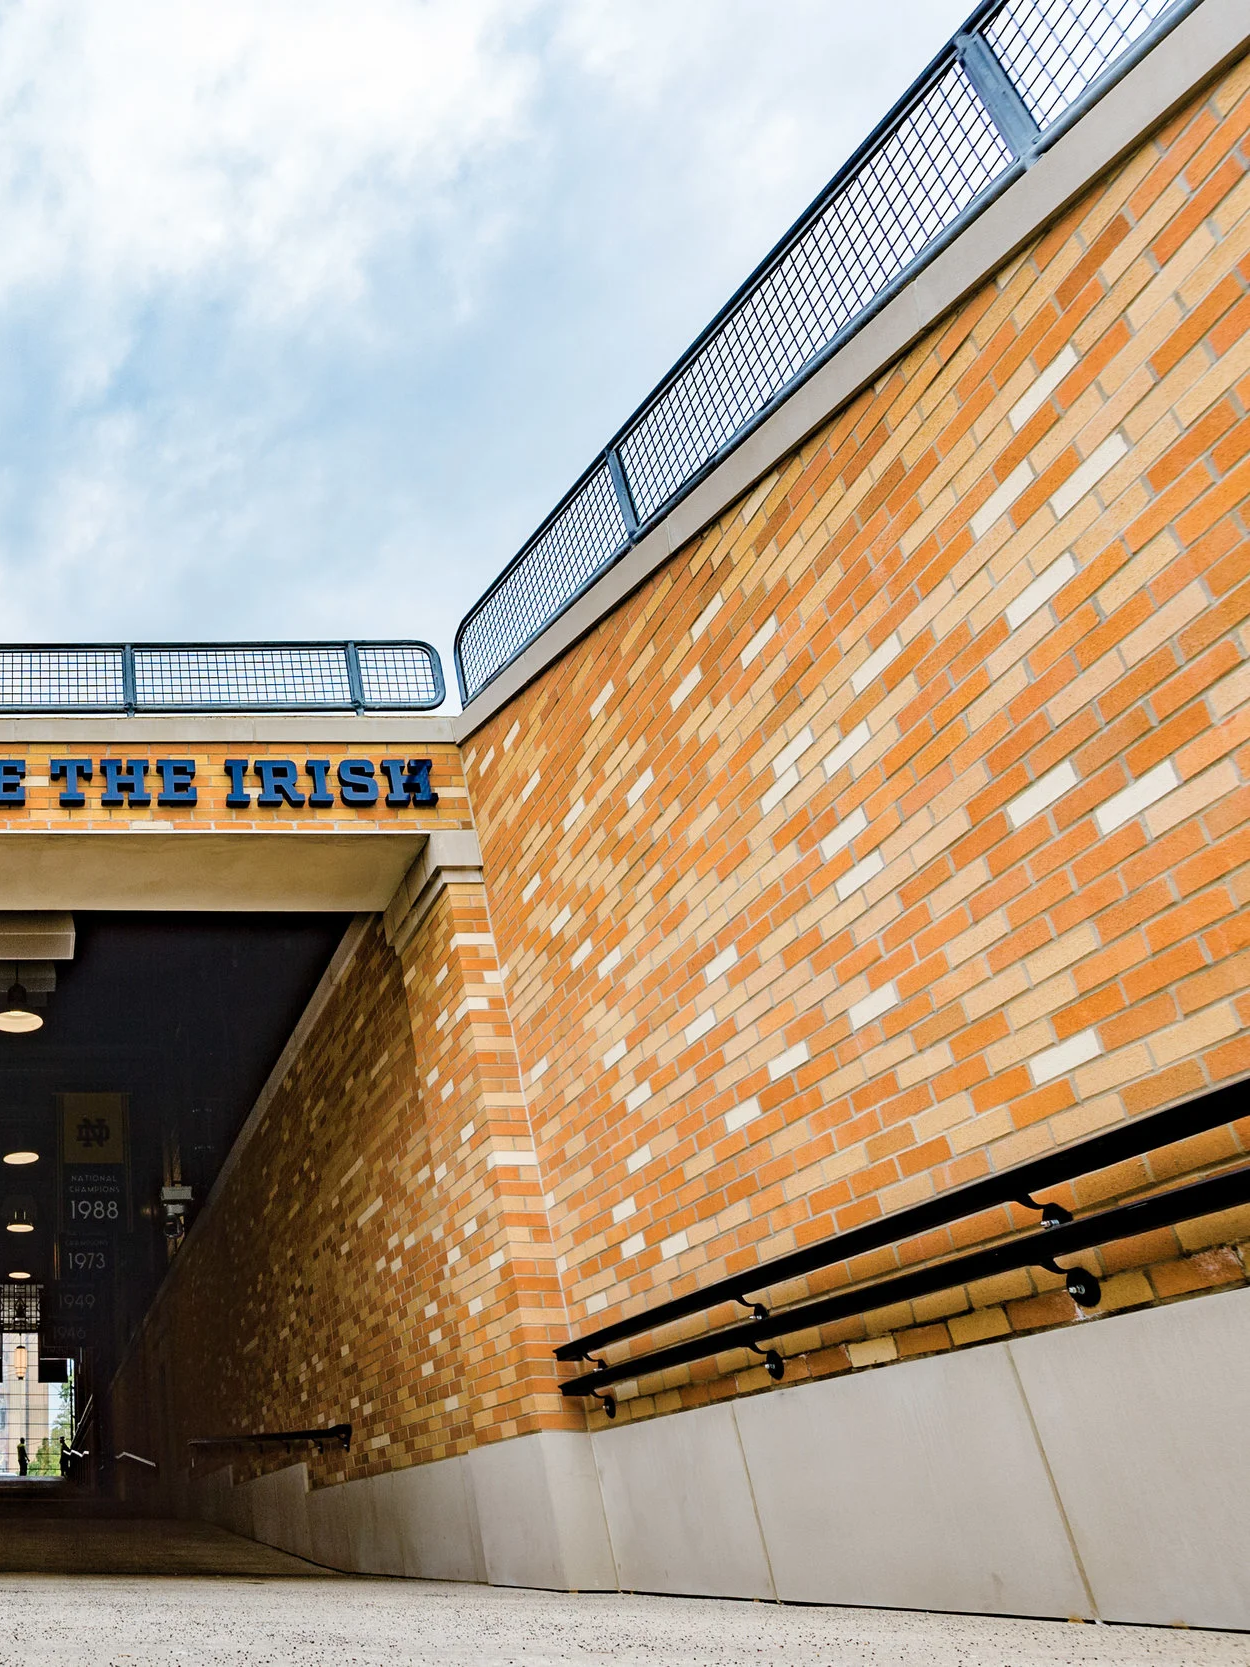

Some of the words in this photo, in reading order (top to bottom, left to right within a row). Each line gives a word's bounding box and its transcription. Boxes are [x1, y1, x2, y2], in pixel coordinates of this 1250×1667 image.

[50, 758, 198, 808] THE
[224, 758, 440, 808] IRISH
[70, 1174, 118, 1183] NATIONAL
[68, 1185, 121, 1194] CHAMPIONS
[70, 1200, 120, 1219] 1988
[68, 1252, 106, 1270] 1973
[58, 1293, 96, 1310] 1949
